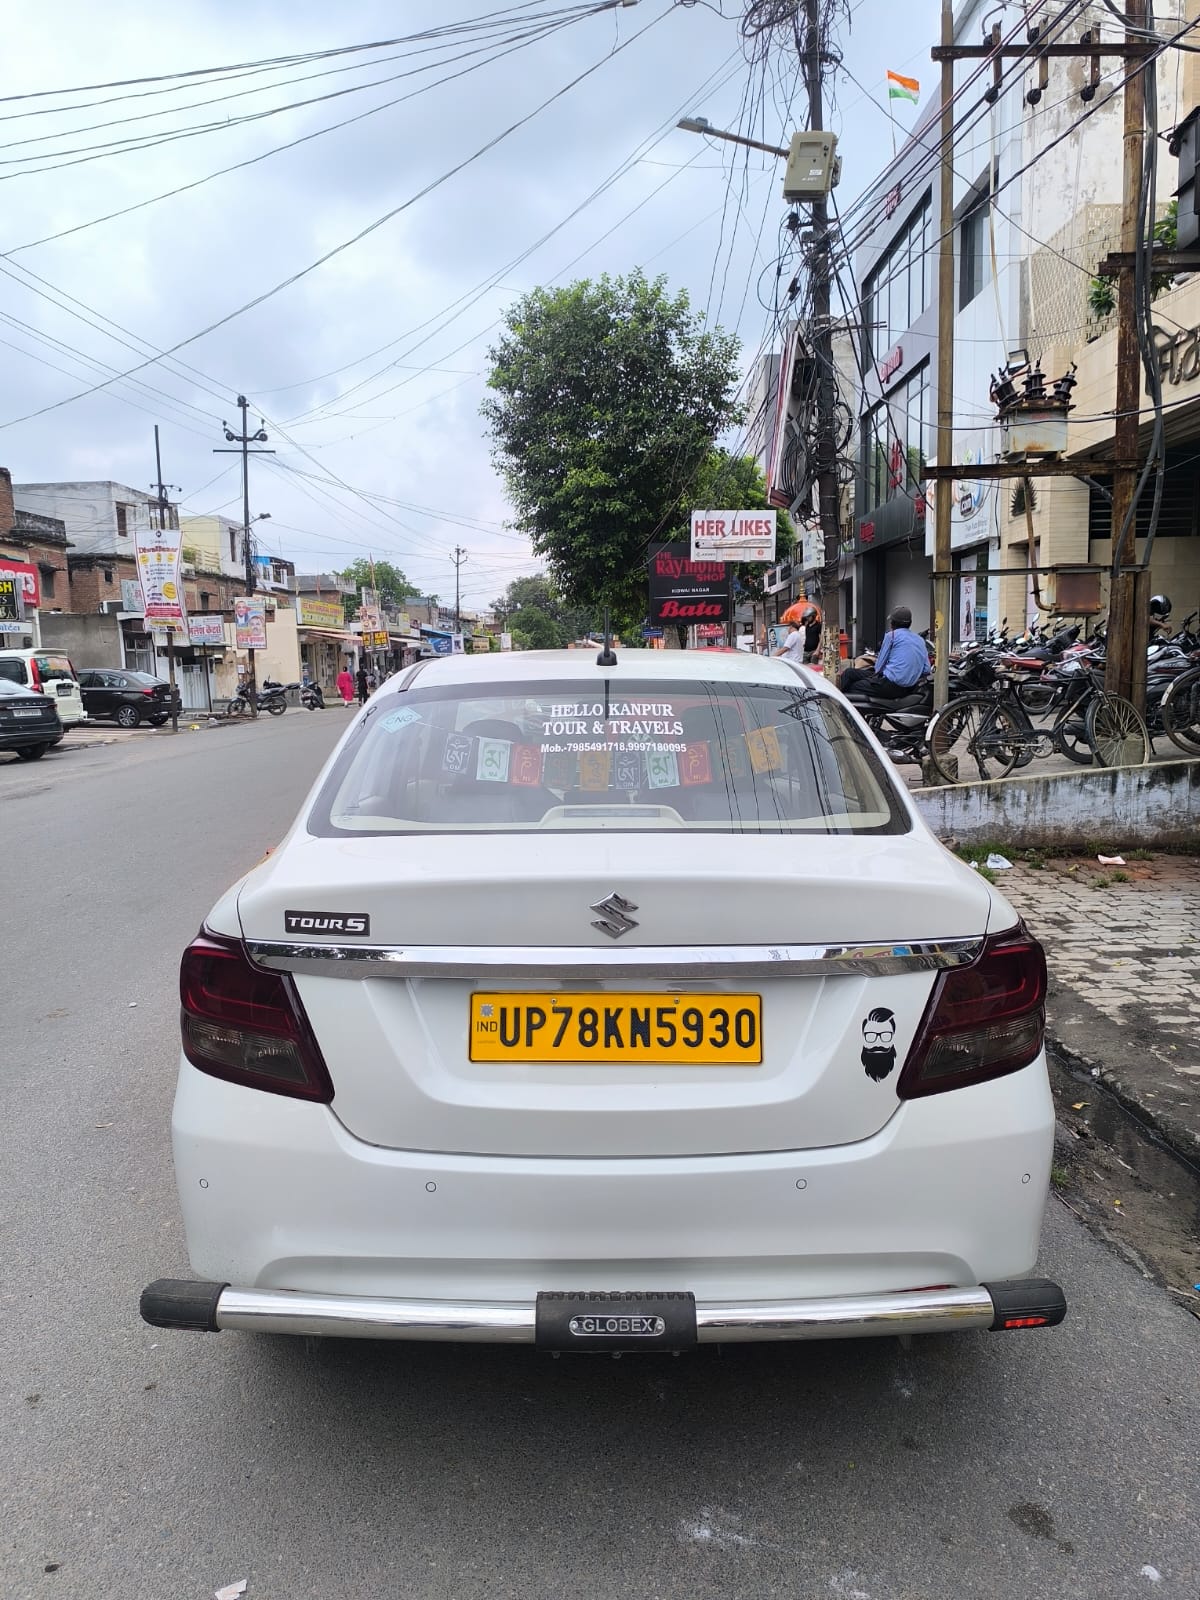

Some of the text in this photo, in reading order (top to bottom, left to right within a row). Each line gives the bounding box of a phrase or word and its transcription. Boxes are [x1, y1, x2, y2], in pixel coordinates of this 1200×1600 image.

[695, 520, 771, 537] HER LIKES
[656, 551, 672, 560] THE
[696, 573, 726, 582] SHOP
[659, 599, 723, 618] Bata
[550, 703, 675, 718] HELLO KANPUR
[386, 714, 413, 725] CNG
[542, 720, 684, 736] TOUR & TRAVELS
[287, 917, 366, 932] TOUR S
[476, 1006, 756, 1049] IND UP78KN5930
[582, 1318, 653, 1333] GLOBEX
